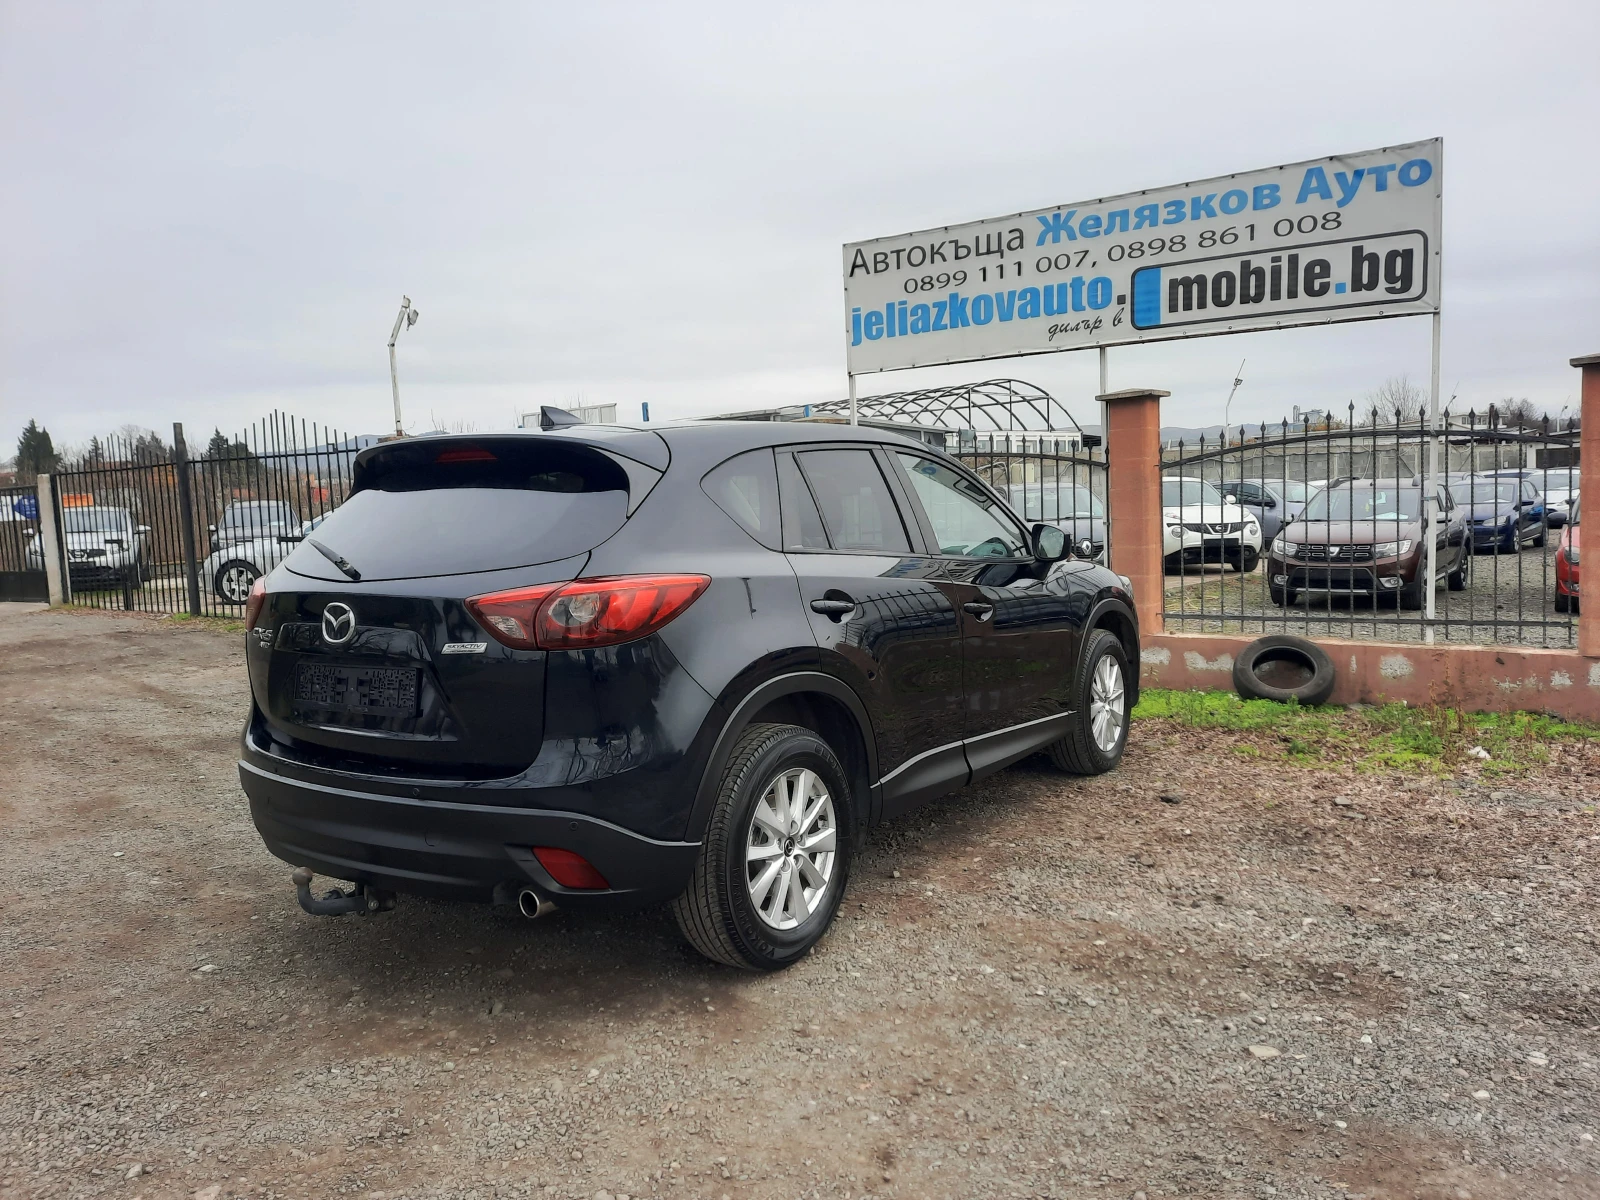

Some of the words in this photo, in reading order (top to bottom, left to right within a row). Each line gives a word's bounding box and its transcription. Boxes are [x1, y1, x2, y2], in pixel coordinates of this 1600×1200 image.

[849, 227, 1024, 278] Автокъща
[1035, 184, 1281, 247] Желязков
[1295, 158, 1433, 208] Ауто
[903, 270, 968, 294] 0899
[978, 260, 1022, 282] 111
[1035, 249, 1097, 273] 007,
[1107, 234, 1187, 262] 0898
[1197, 223, 1255, 249] 861
[1273, 211, 1342, 237] 008
[1168, 244, 1414, 314] mobile.bg
[1048, 315, 1103, 341] дилър
